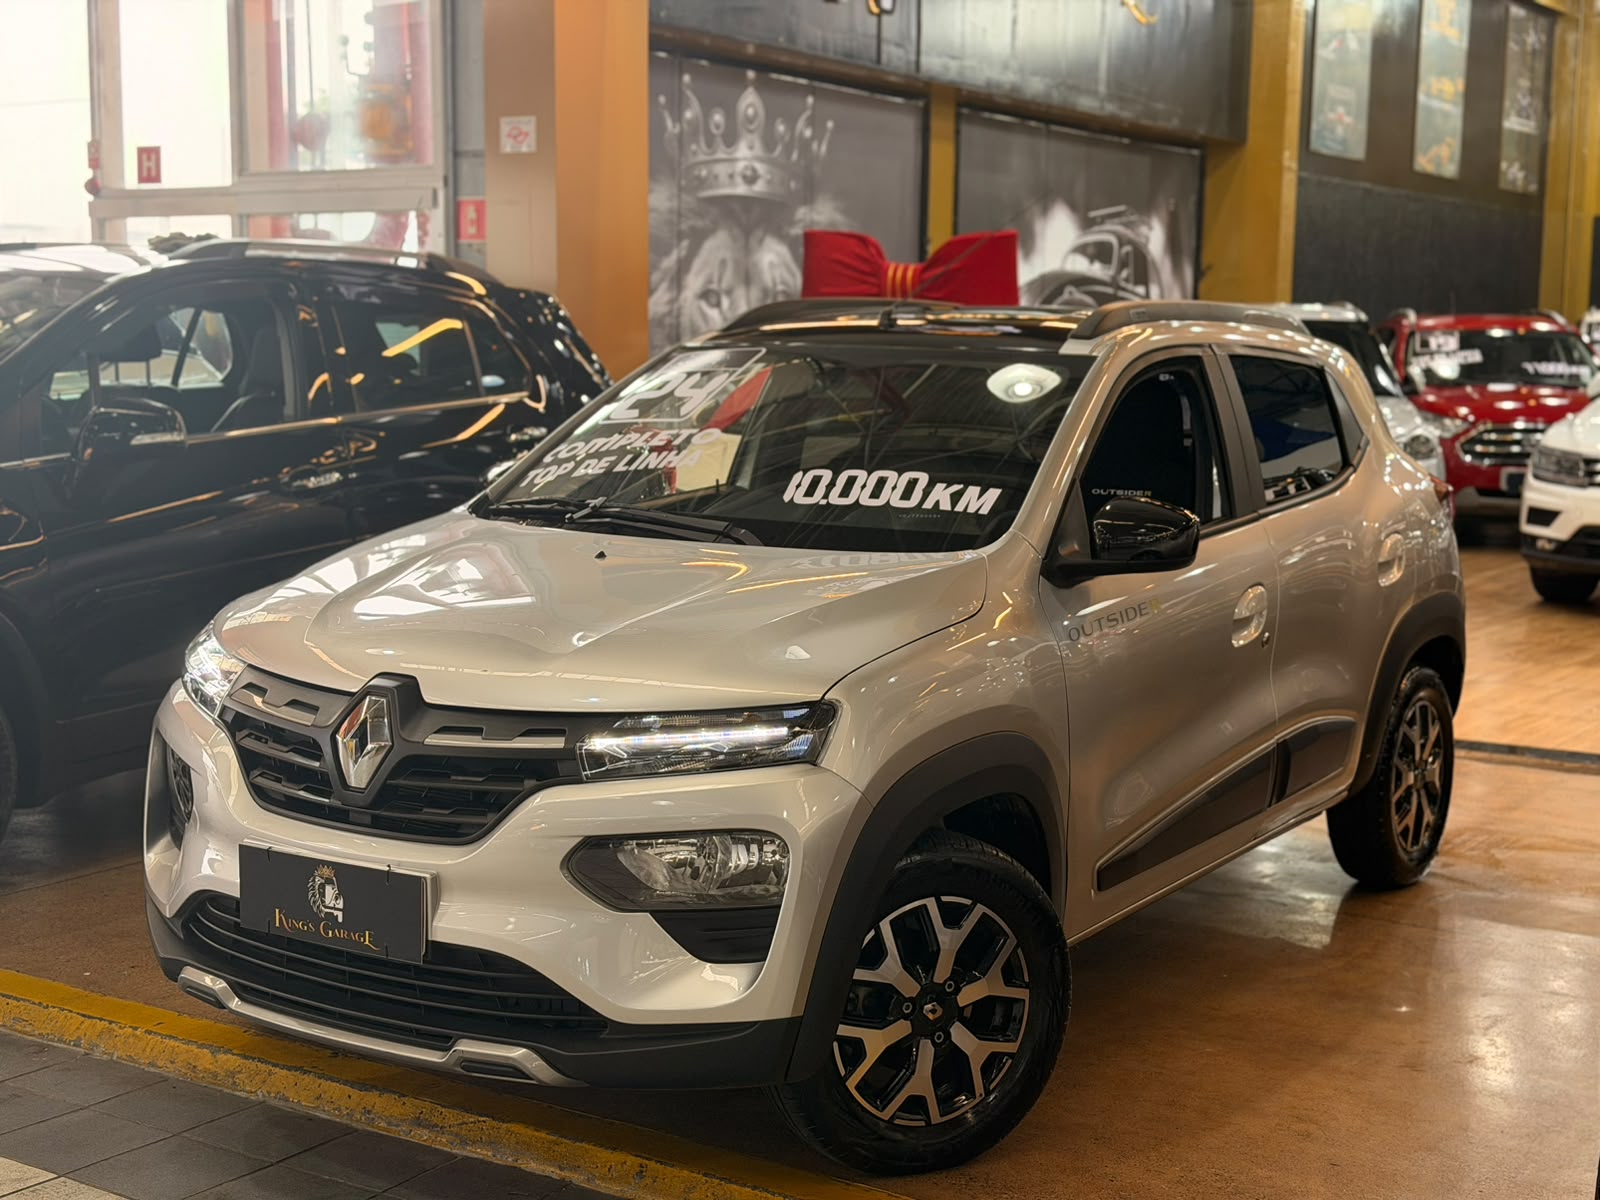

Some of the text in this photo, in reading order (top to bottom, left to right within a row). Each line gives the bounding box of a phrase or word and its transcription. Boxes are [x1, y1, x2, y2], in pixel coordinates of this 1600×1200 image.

[141, 152, 157, 177] H
[610, 371, 730, 419] 24
[543, 428, 722, 464] COMPLETO
[520, 449, 704, 488] TOP DE LINHA
[783, 469, 1002, 515] 10.000 KM
[1091, 488, 1152, 497] OUTSIDER
